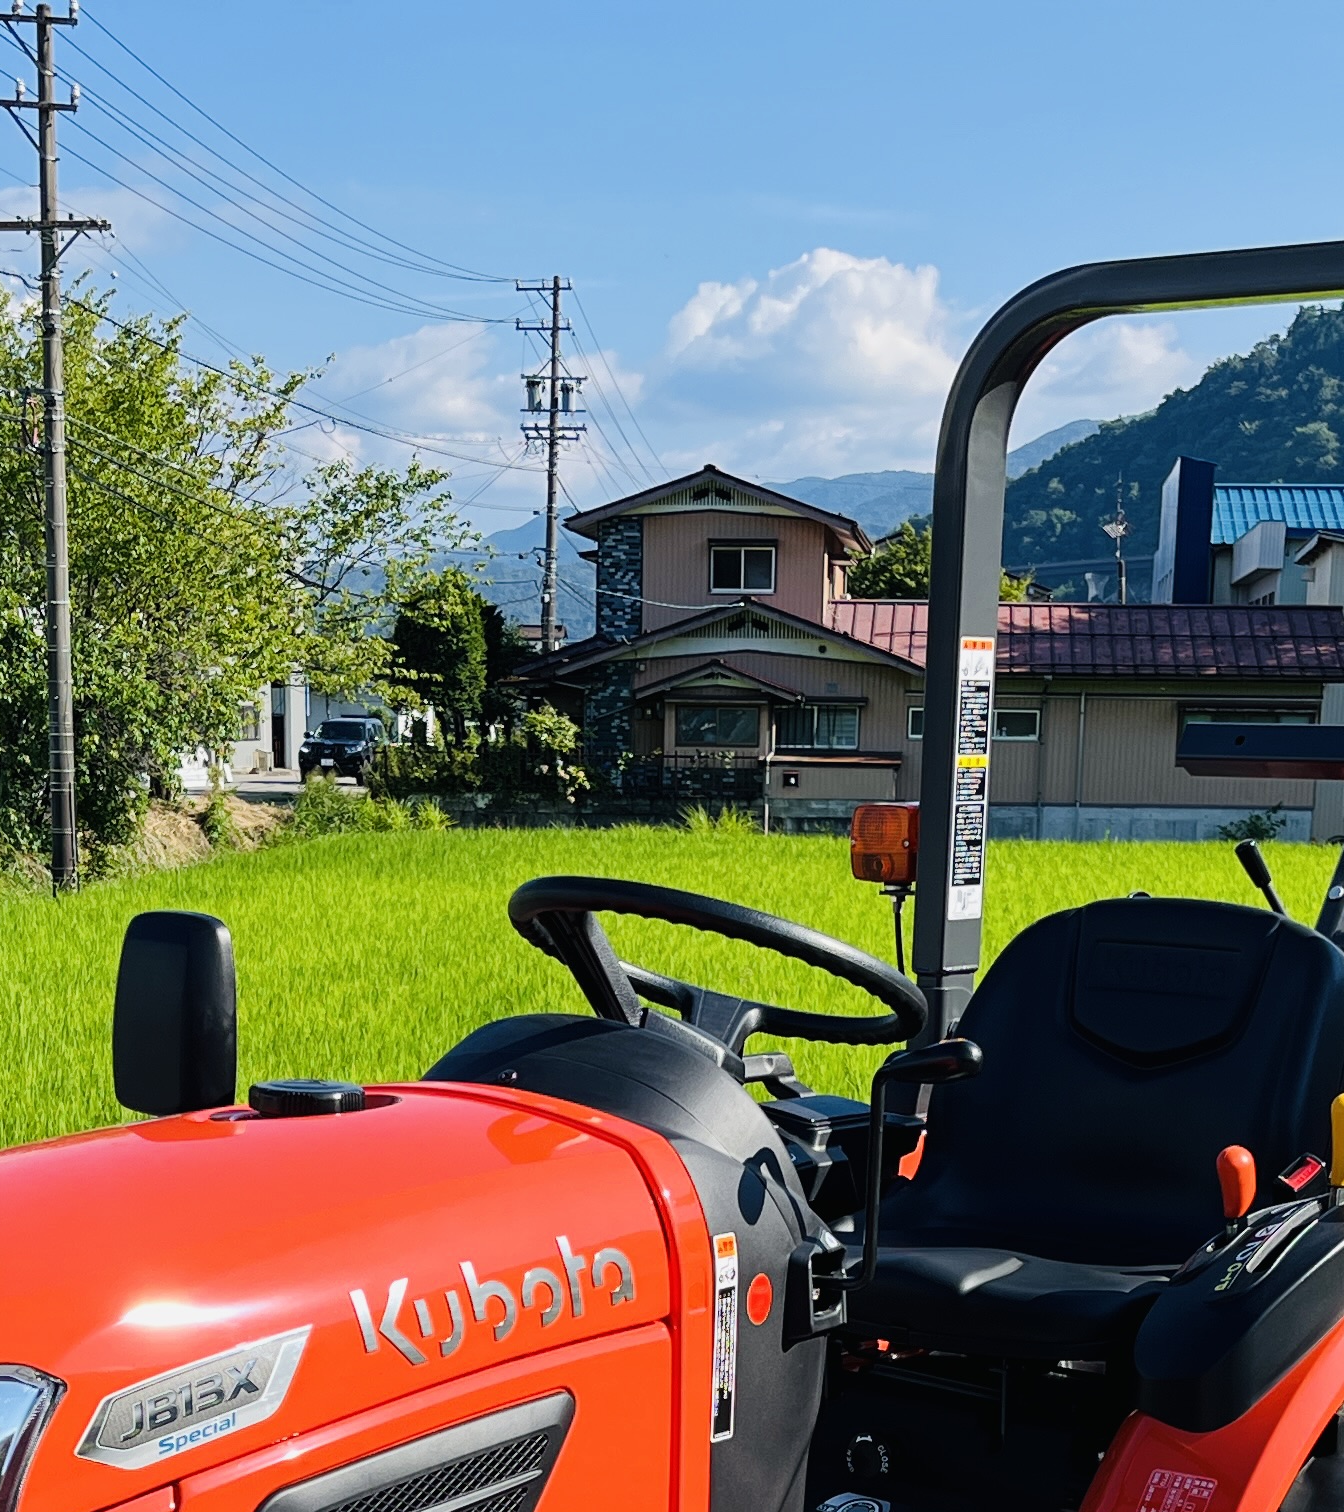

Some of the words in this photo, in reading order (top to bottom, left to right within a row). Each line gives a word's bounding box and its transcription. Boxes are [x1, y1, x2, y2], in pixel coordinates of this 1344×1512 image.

[349, 1235, 635, 1366] Kubota
[119, 1358, 260, 1443] JB13X
[158, 1412, 236, 1455] Special
[877, 1444, 889, 1474] CLOSE
